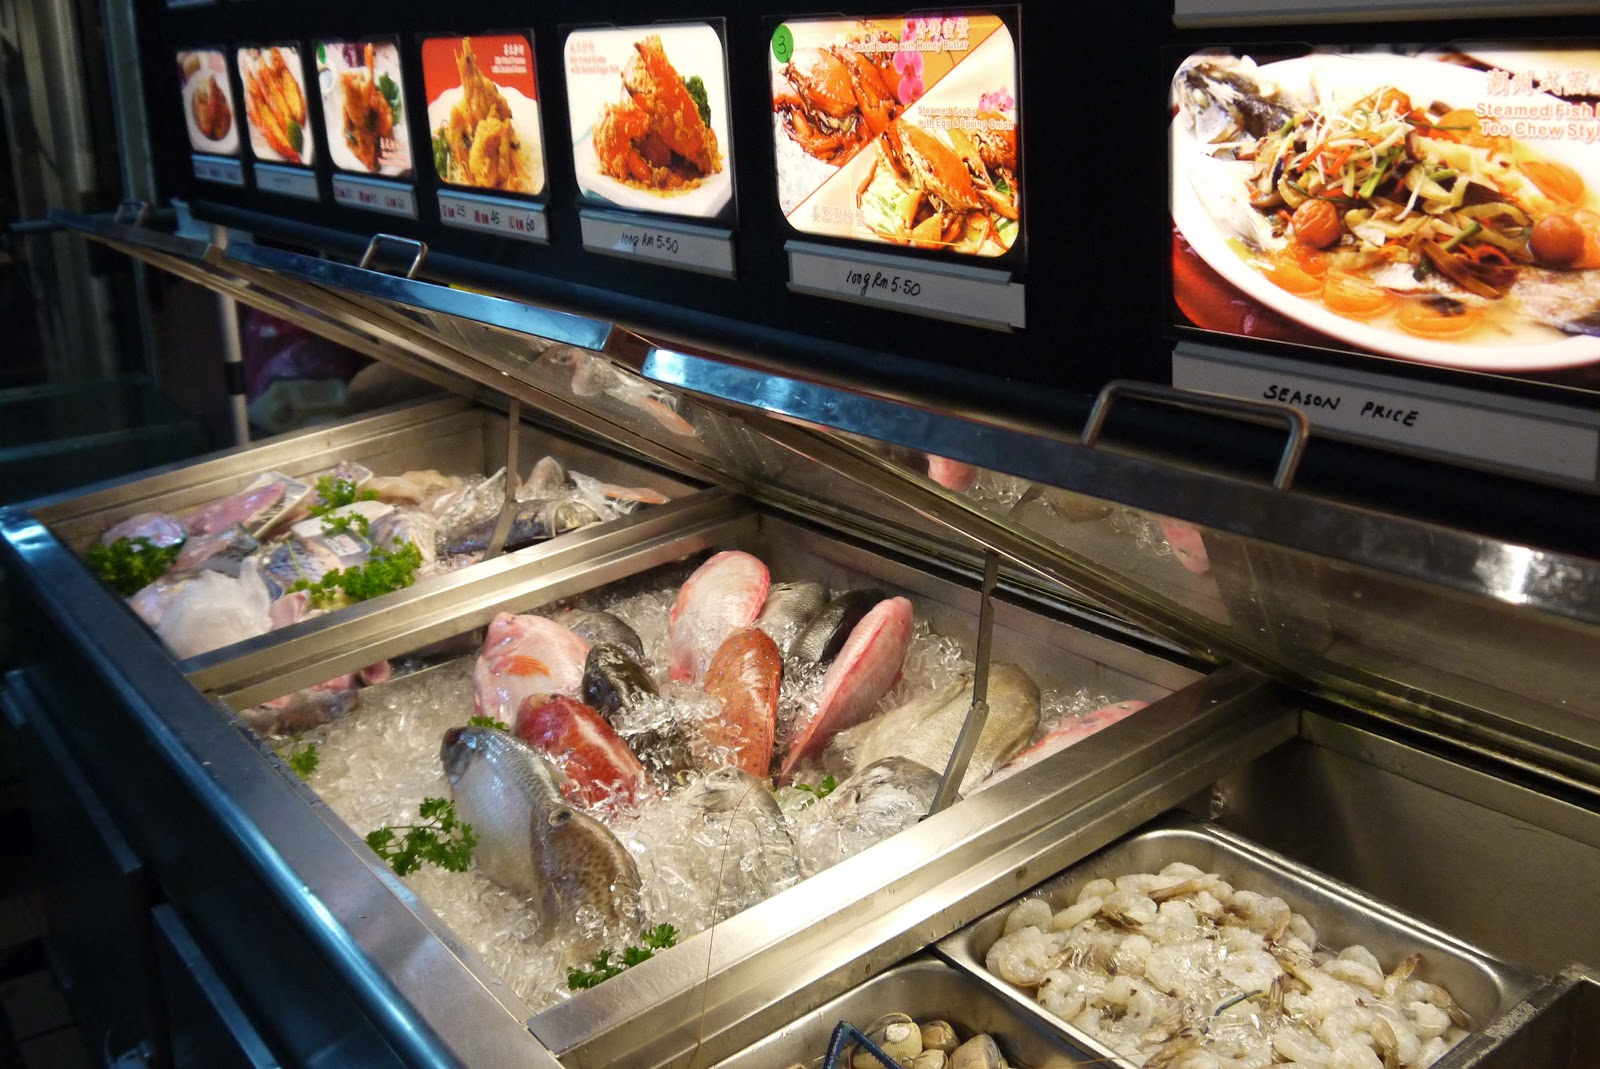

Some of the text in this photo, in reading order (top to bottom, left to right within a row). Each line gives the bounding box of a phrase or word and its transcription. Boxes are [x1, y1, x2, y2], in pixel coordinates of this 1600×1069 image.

[778, 35, 786, 54] 3
[854, 41, 968, 53] Baked Crabs with Honey Butter
[1486, 68, 1600, 96] 潮州式蒸
[918, 106, 976, 116] Steamed Crabs
[1477, 103, 1549, 117] Steamed
[1556, 103, 1593, 117] Fish
[918, 118, 1013, 129] with Egg & Spring Onion
[1481, 121, 1600, 139] Teo Chew Styl
[657, 235, 679, 254] 5.50
[846, 270, 871, 296] 100g
[891, 277, 921, 296] 5.50
[1263, 385, 1419, 427] SEASON PRICE
